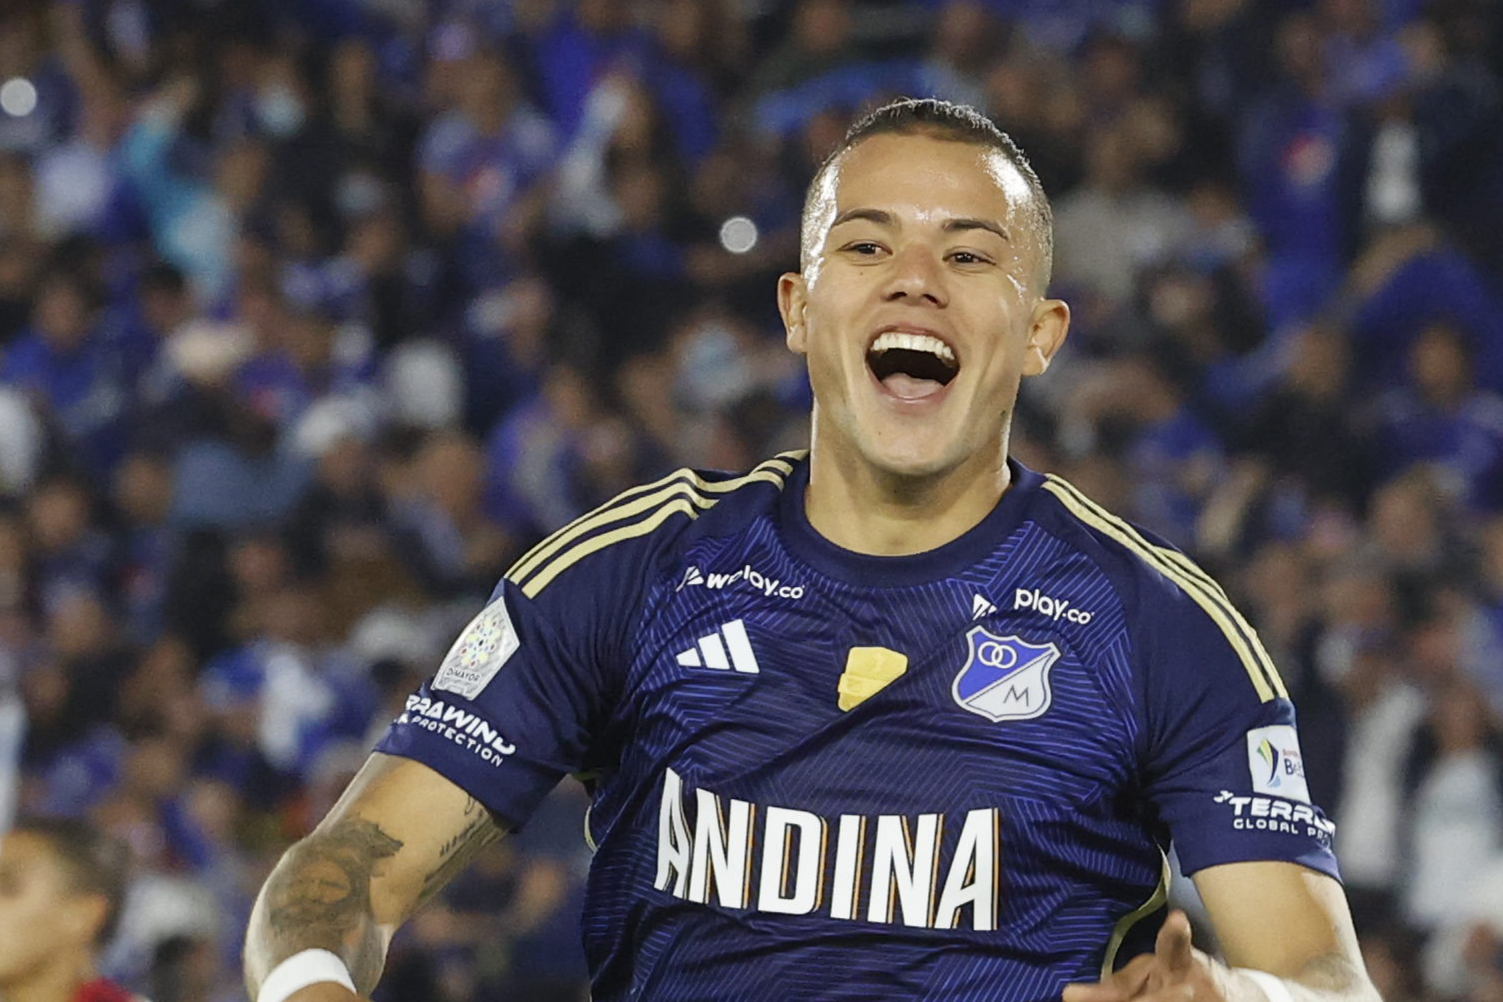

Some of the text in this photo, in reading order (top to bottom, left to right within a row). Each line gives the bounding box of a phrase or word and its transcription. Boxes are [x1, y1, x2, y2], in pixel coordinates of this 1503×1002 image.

[1003, 685, 1030, 707] M
[411, 716, 505, 768] PROTECTION
[1233, 818, 1299, 835] GLOBAL
[654, 766, 999, 931] ANDINA
